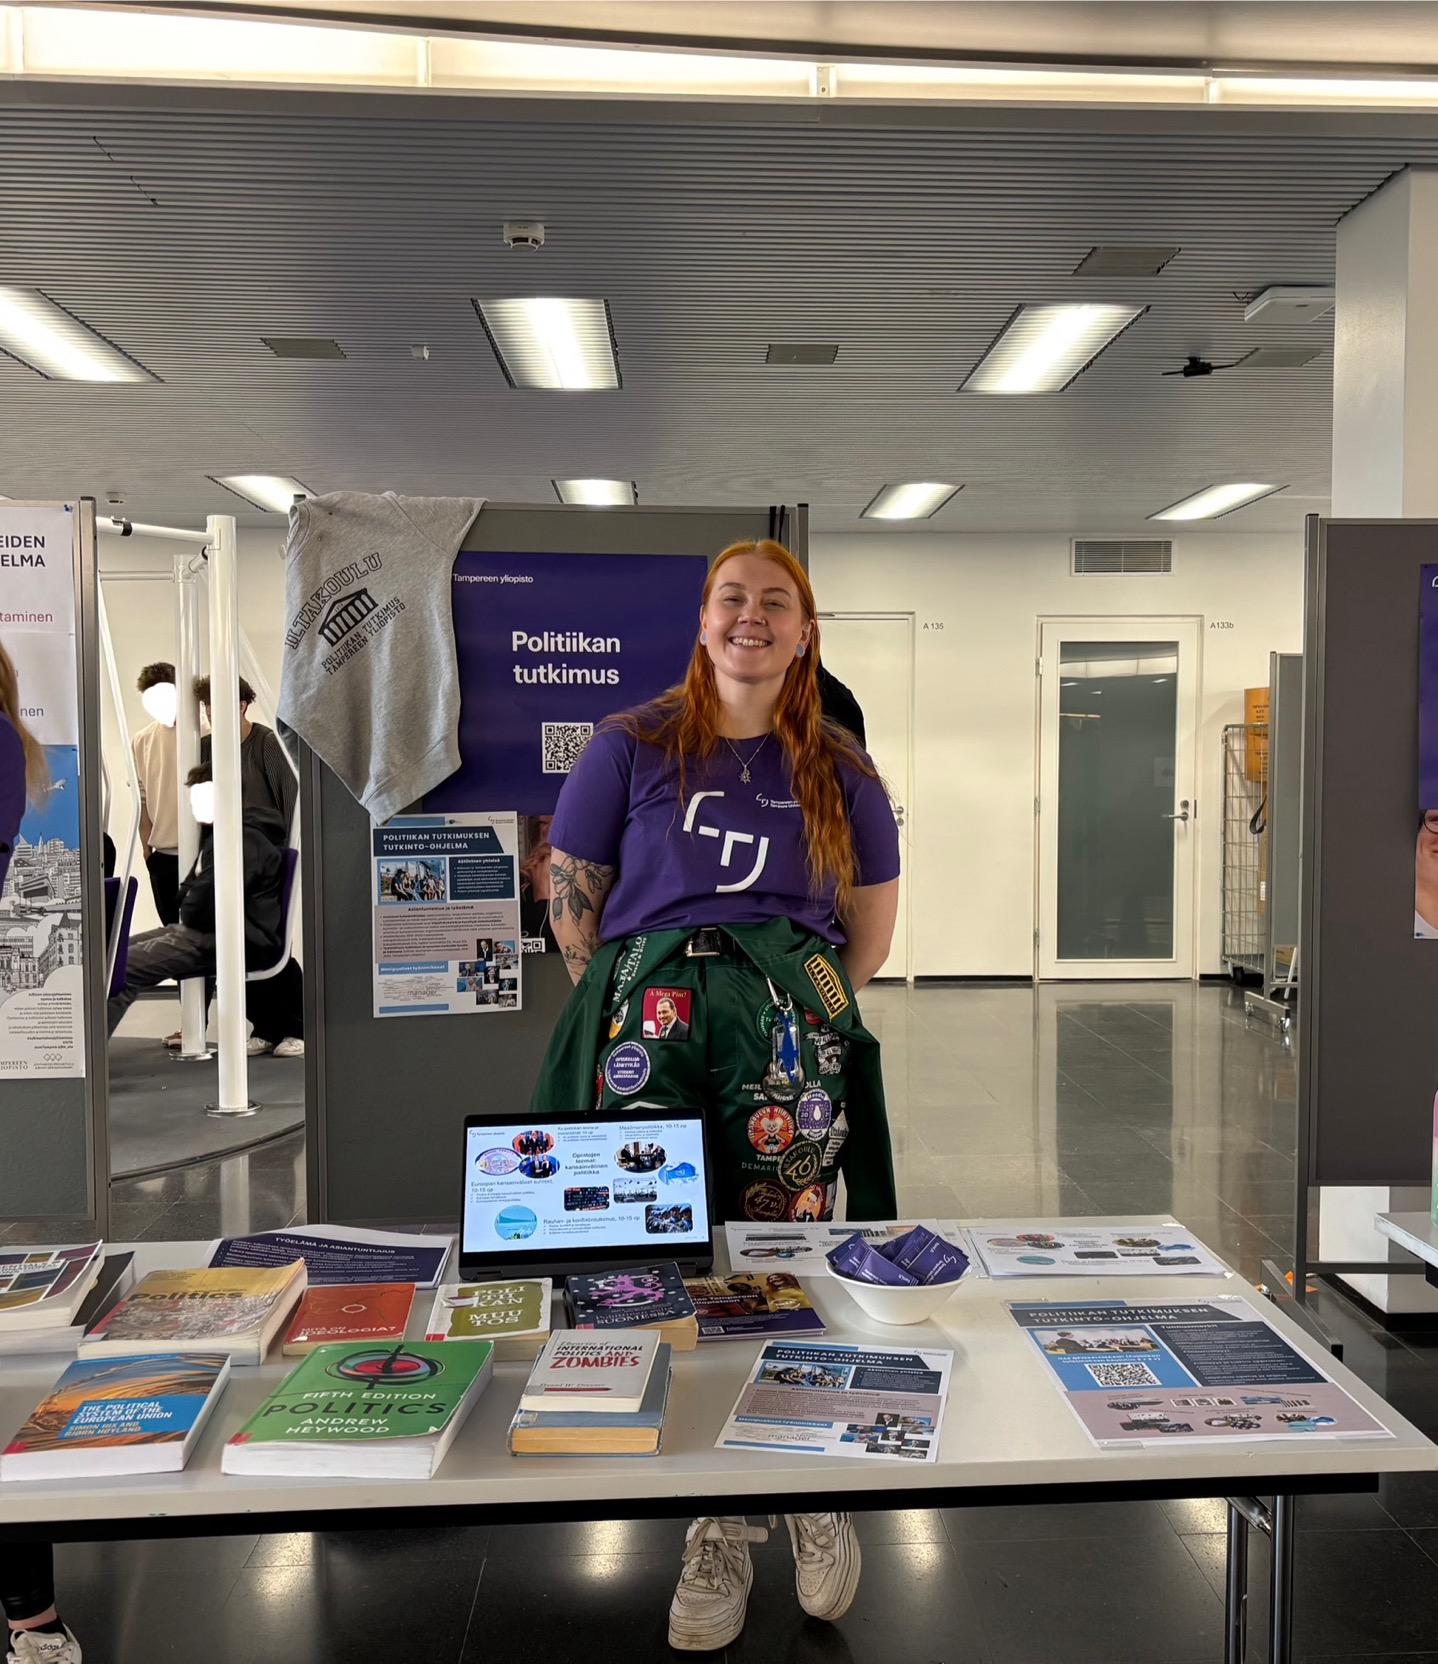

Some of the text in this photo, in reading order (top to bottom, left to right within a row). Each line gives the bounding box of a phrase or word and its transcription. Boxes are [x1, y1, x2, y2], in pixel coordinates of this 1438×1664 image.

[0, 554, 46, 568] ELMA
[452, 573, 534, 584] Tampereen yliopisto
[285, 552, 382, 650] ILTAKOULU
[321, 596, 400, 670] POLITIIKAN TUTKIMUS
[326, 602, 406, 676] TAMPEREEN YLIOPISTO
[512, 631, 621, 653] Politiikan
[513, 664, 620, 685] tutkimus
[383, 842, 468, 851] TUTKINTO-OHJELMA
[808, 964, 835, 1012] ILTAKOULU
[783, 1155, 812, 1182] 46
[276, 1237, 316, 1247] TYÖELÄMÄ
[330, 1244, 396, 1254] ASIANTUNTIJUUS
[474, 1286, 526, 1296] POLI
[471, 1297, 524, 1308] KAN
[468, 1309, 523, 1321] MUU
[471, 1316, 519, 1326] TOS
[597, 1310, 675, 1324] SUOMESSA
[1032, 1315, 1178, 1324] TUTKINTO-OHJELMA
[300, 1326, 397, 1336] IDEOLOGIA?
[775, 1354, 884, 1365] TUTKINTO-OHJELMA
[776, 1349, 914, 1362] POLITIIKAN TUTKIMUKSEN
[550, 1356, 641, 1368] ZOMBIES
[105, 1402, 161, 1410] POLITICAL
[262, 1402, 447, 1417] POLITICS
[73, 1412, 172, 1424] EUROPEAN UNION
[286, 1426, 390, 1434] HEYWOOD
